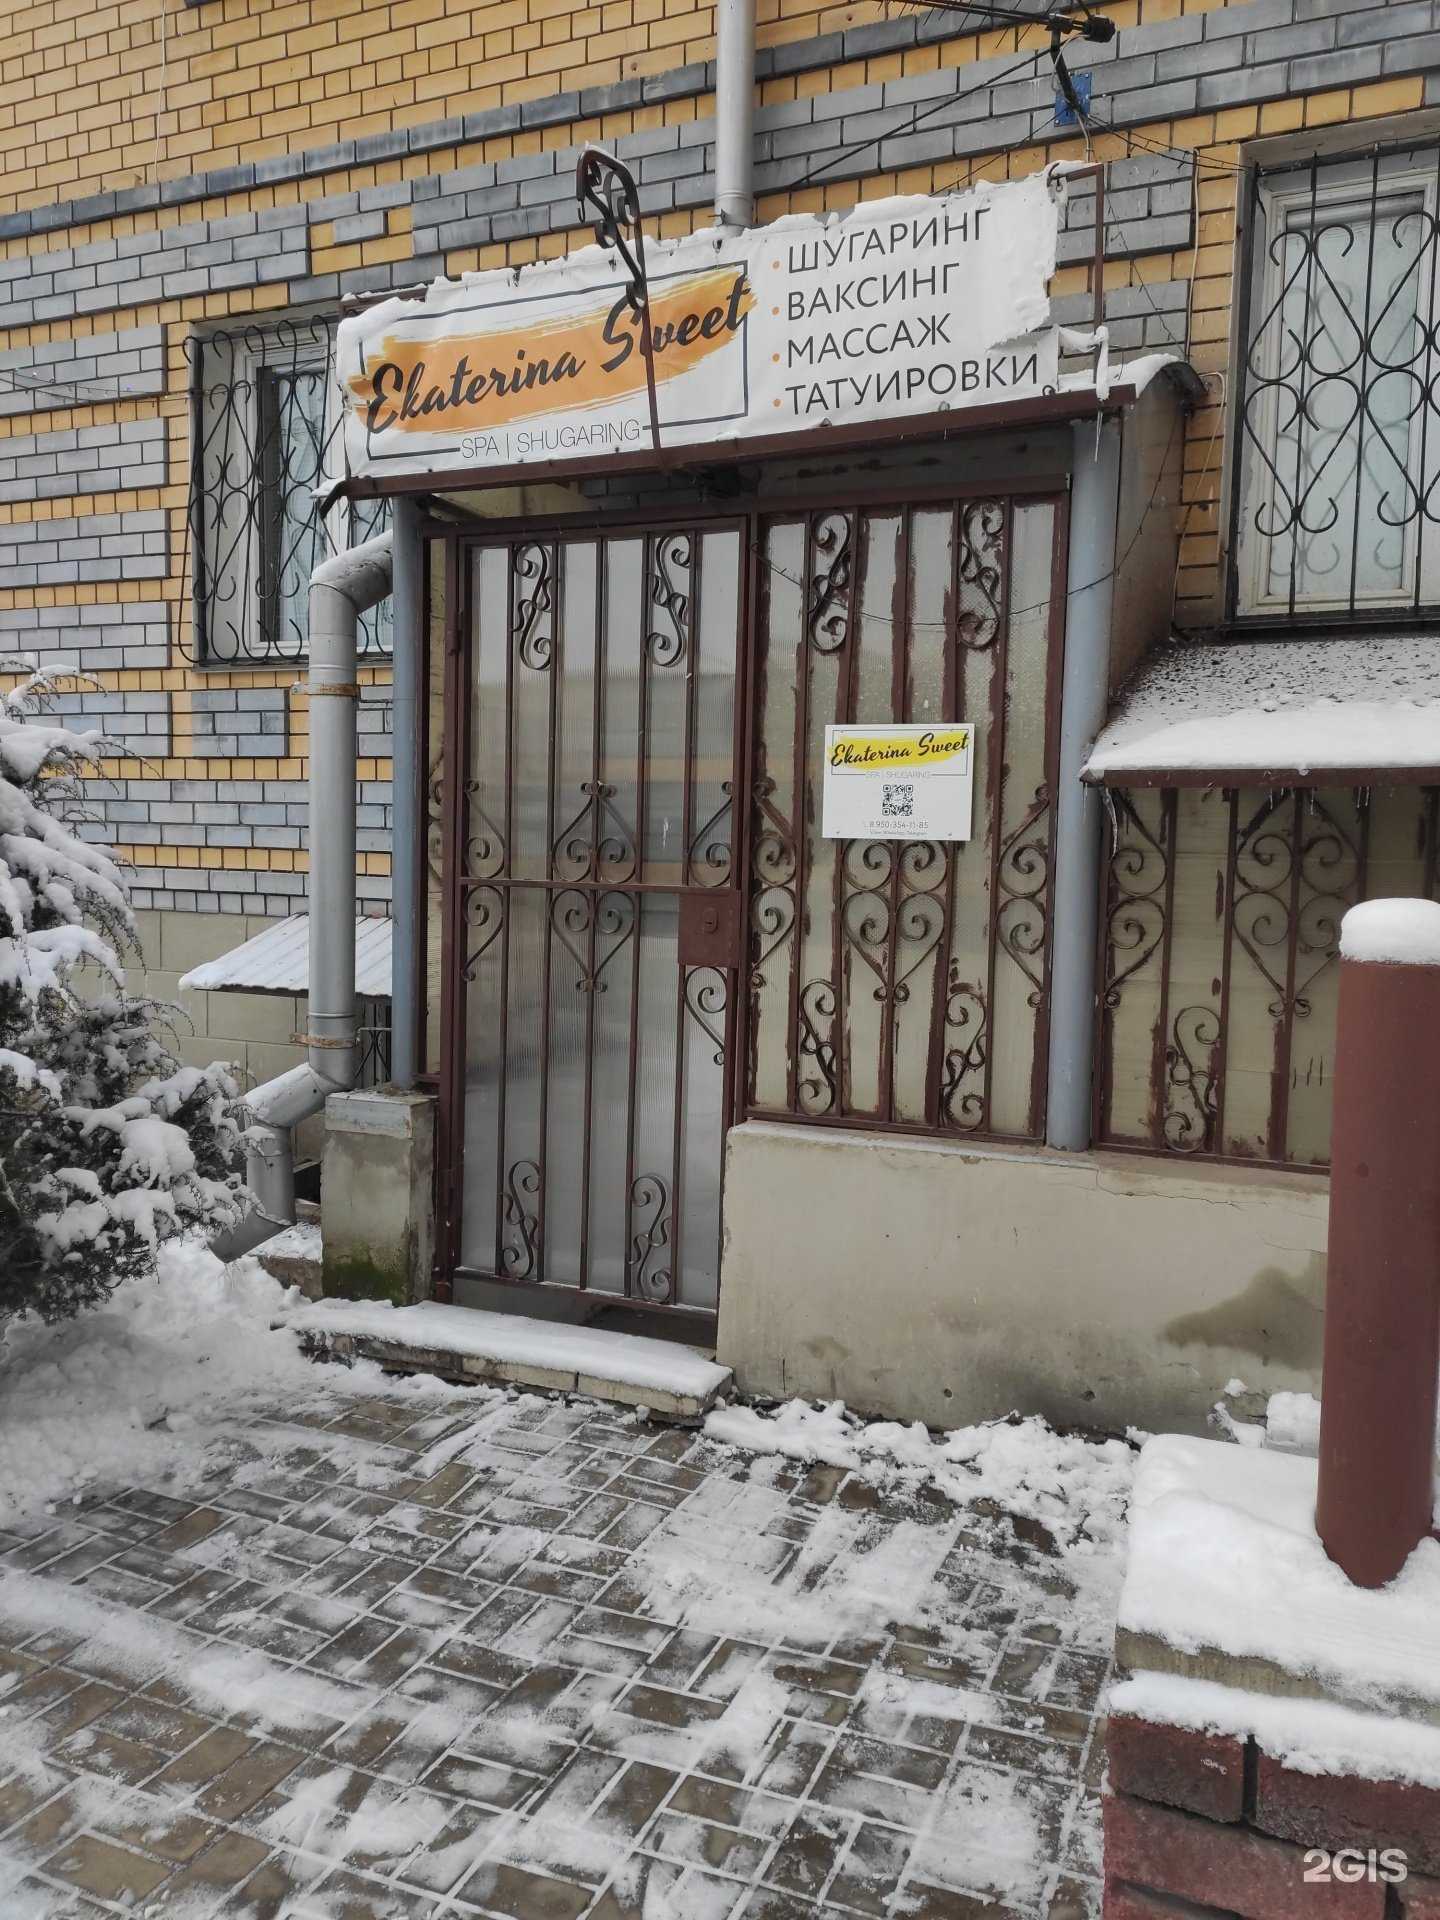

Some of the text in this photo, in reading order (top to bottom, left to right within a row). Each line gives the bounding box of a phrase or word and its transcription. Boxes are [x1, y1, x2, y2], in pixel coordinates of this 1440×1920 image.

[788, 207, 991, 274] ШУГАРИНГ
[788, 262, 960, 321] ВАКСИНГ
[366, 273, 752, 434] Ekaterina Sweet
[788, 313, 951, 368] МАССАЖ
[785, 353, 1038, 415] ТАТУИРОВКИ
[461, 436, 500, 459] SPA
[517, 419, 641, 453] SHUGARING
[831, 732, 969, 767] Ekaterina Sweet
